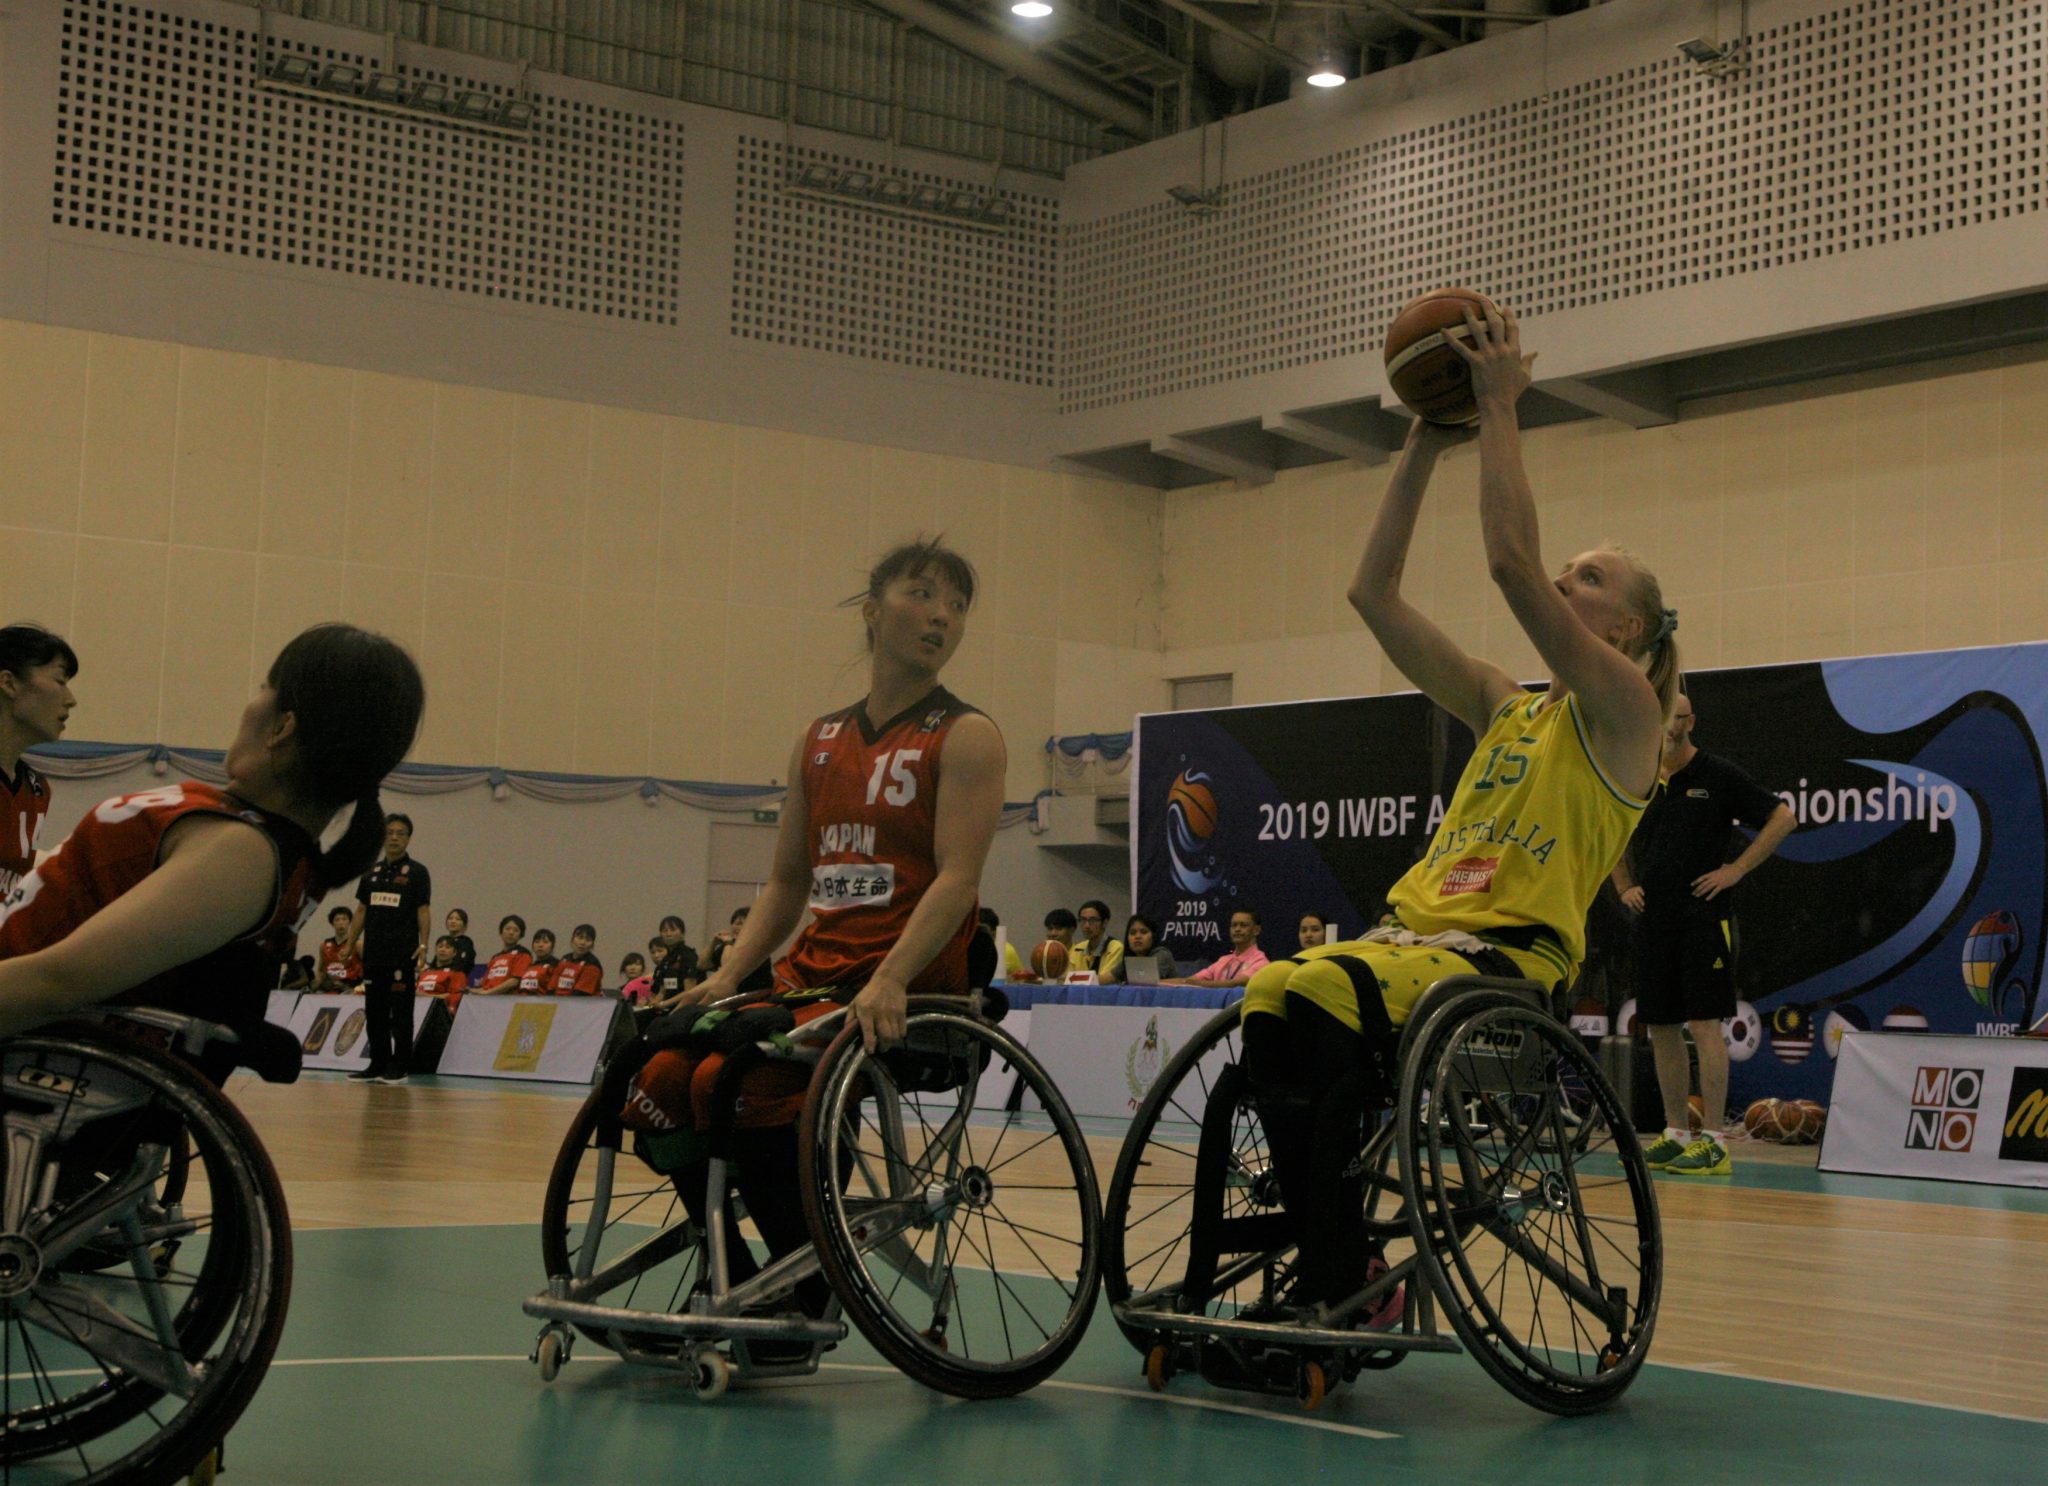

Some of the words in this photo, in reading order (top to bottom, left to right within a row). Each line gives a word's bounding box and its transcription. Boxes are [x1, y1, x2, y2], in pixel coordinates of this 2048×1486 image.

[865, 748, 923, 807] 15
[1475, 736, 1538, 790] 15
[1258, 801, 1330, 841] 2019
[1338, 795, 1417, 838] IWBF
[819, 822, 876, 858] JAPAN
[824, 876, 889, 898] 日本生命
[1176, 900, 1208, 917] 2019
[1161, 920, 1223, 943] PATTAYA
